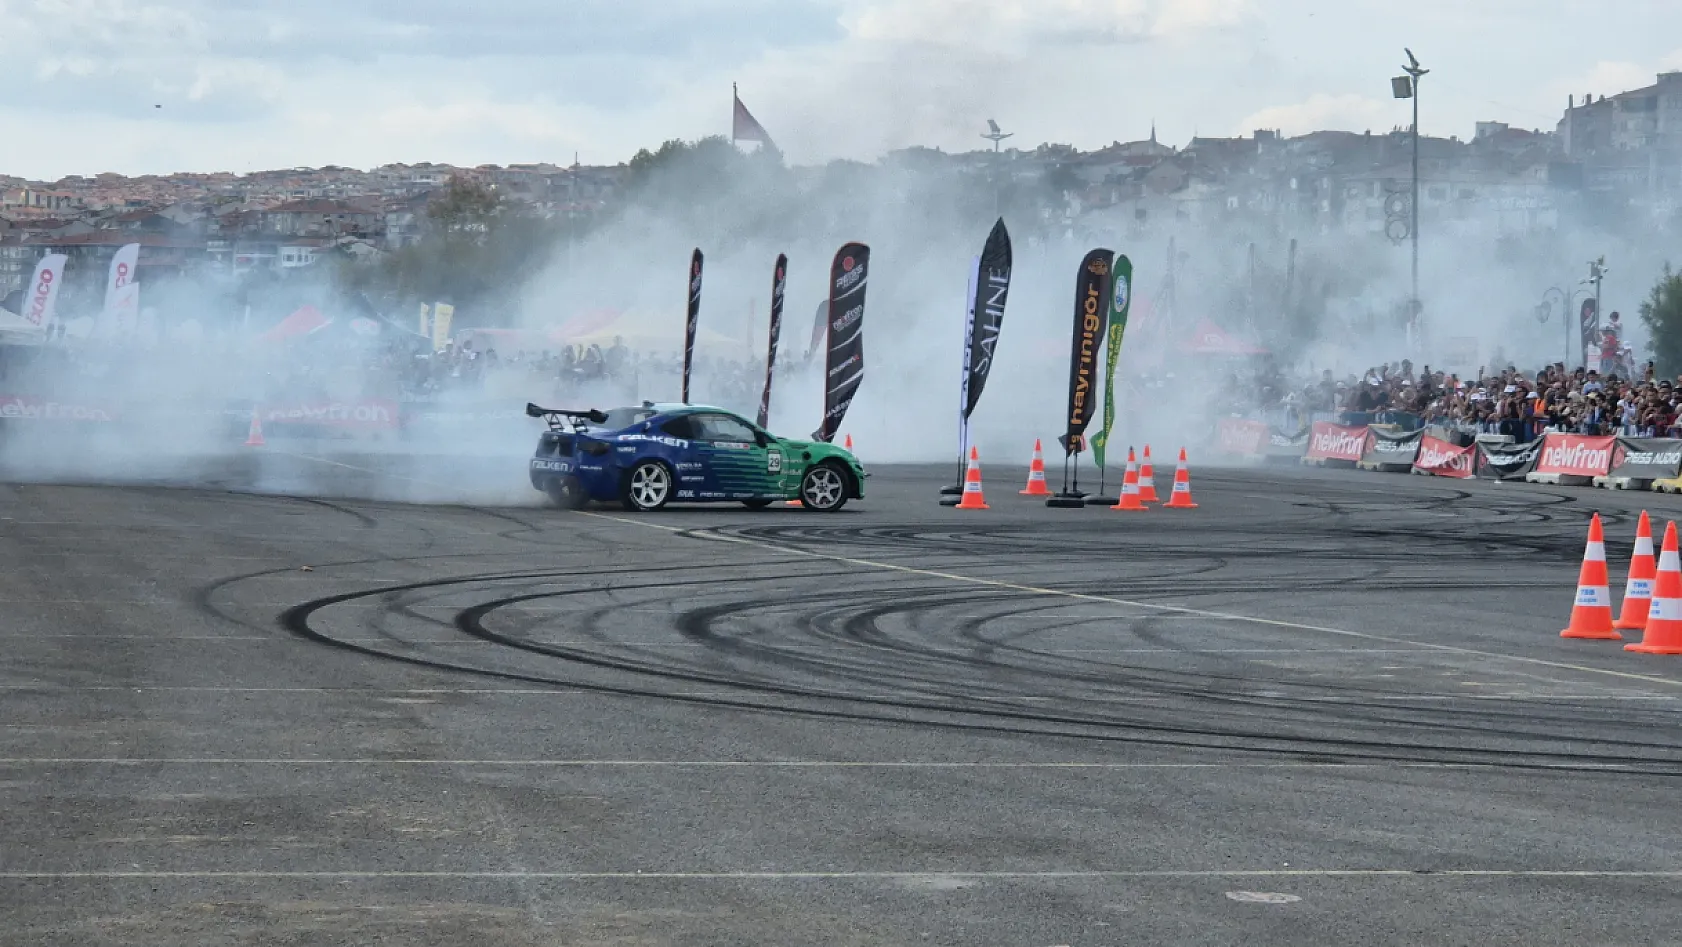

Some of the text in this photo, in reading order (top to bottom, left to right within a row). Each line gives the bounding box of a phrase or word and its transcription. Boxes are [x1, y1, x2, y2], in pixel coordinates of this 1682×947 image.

[974, 266, 1010, 376] SAHNE
[618, 434, 688, 449] FALKEN
[1543, 440, 1607, 469] newfron
[532, 460, 569, 472] FALKEN
[769, 457, 780, 468] 29
